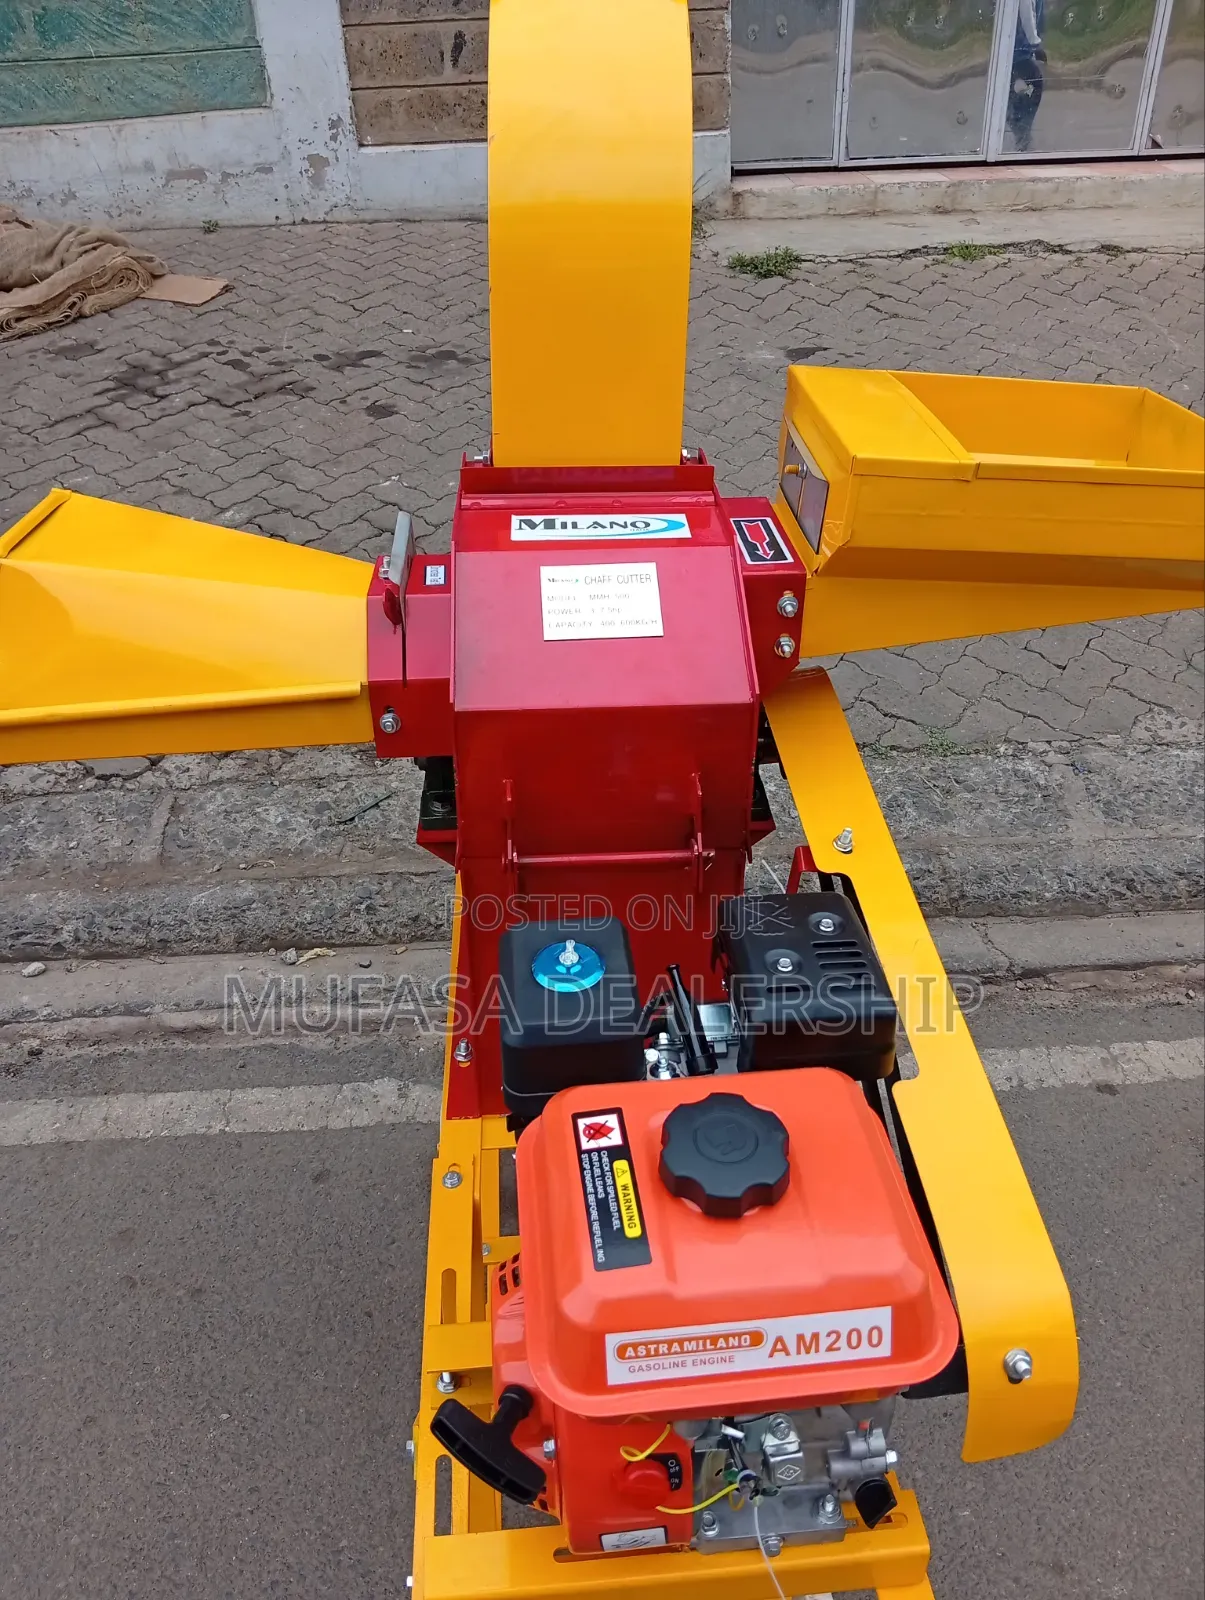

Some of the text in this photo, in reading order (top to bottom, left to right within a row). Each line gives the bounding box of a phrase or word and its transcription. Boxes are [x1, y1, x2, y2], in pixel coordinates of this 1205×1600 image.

[515, 518, 651, 531] MILANO
[584, 575, 612, 586] CHAFF
[616, 573, 652, 585] CUTTER
[581, 1153, 590, 1170] STOP
[600, 1150, 611, 1171] CHECK
[583, 1170, 595, 1194] ENGINE
[590, 1151, 605, 1199] OR FUEL LEAKS
[604, 1171, 614, 1185] FOR
[586, 1193, 599, 1221] BEFORE
[620, 1183, 637, 1230] WARNING
[611, 1211, 621, 1230] FUEL
[624, 1334, 751, 1358] ASTRAMILANO
[767, 1325, 884, 1359] AM200
[628, 1355, 736, 1374] GASOLINE ENGINE
